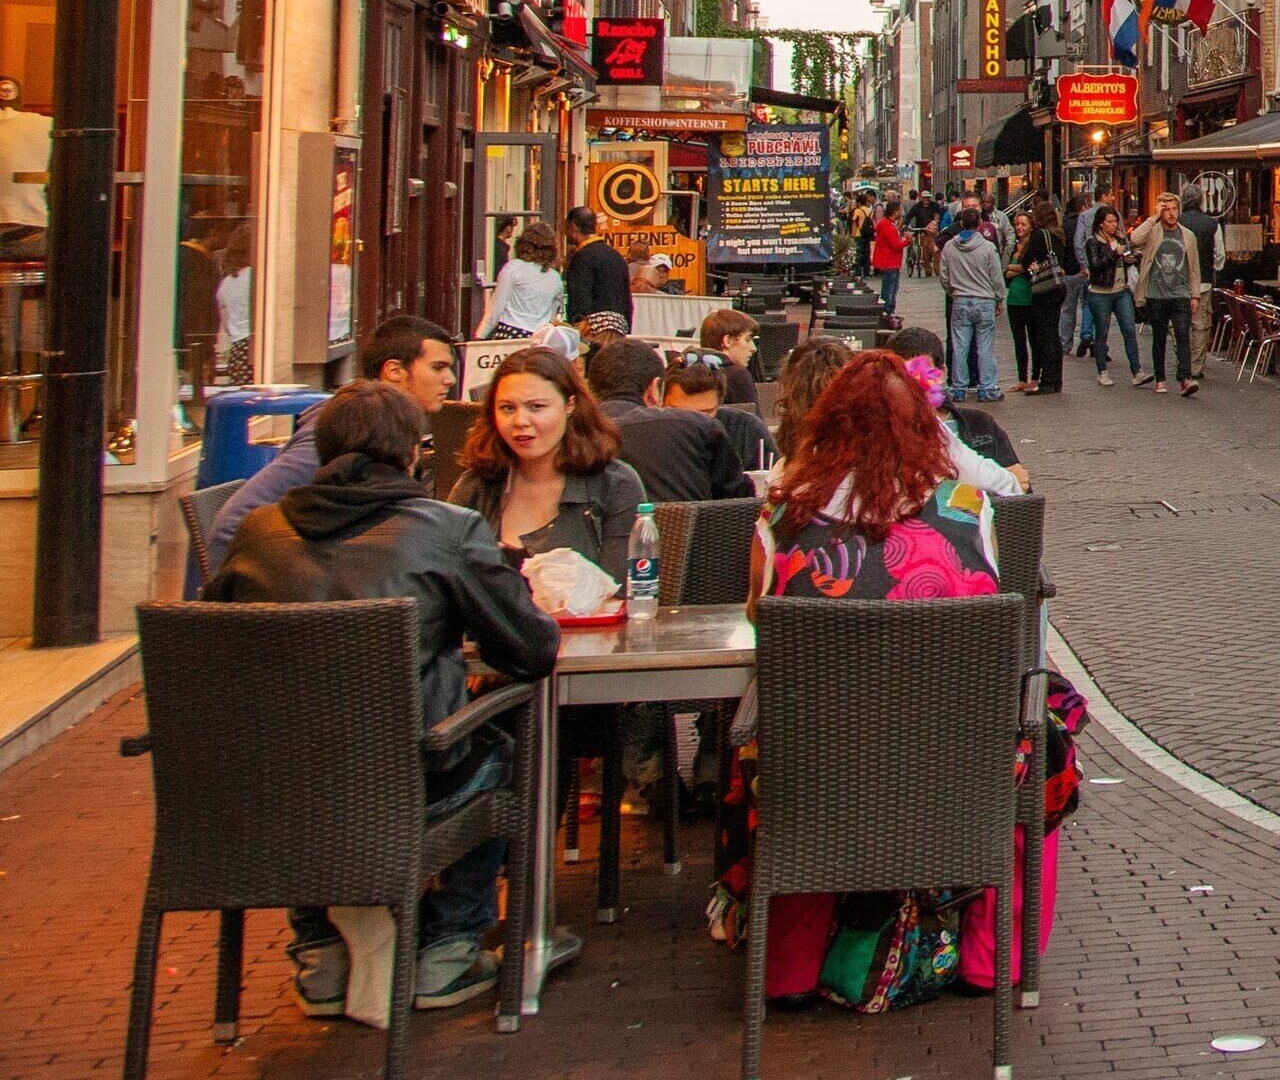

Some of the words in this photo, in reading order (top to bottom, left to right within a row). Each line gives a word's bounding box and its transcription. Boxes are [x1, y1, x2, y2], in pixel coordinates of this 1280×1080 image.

[597, 21, 658, 38] Rancho
[609, 67, 645, 79] GRILL
[1069, 82, 1127, 94] ALBERTO'S
[1082, 107, 1126, 115] STEAKHOUSE
[748, 139, 822, 156] PUBCRAWL
[719, 156, 822, 168] LEIDSEPLEIN
[722, 178, 779, 193] STARTS
[782, 177, 816, 192] HERE
[602, 232, 678, 248] NTERNET
[476, 353, 509, 370] GA
